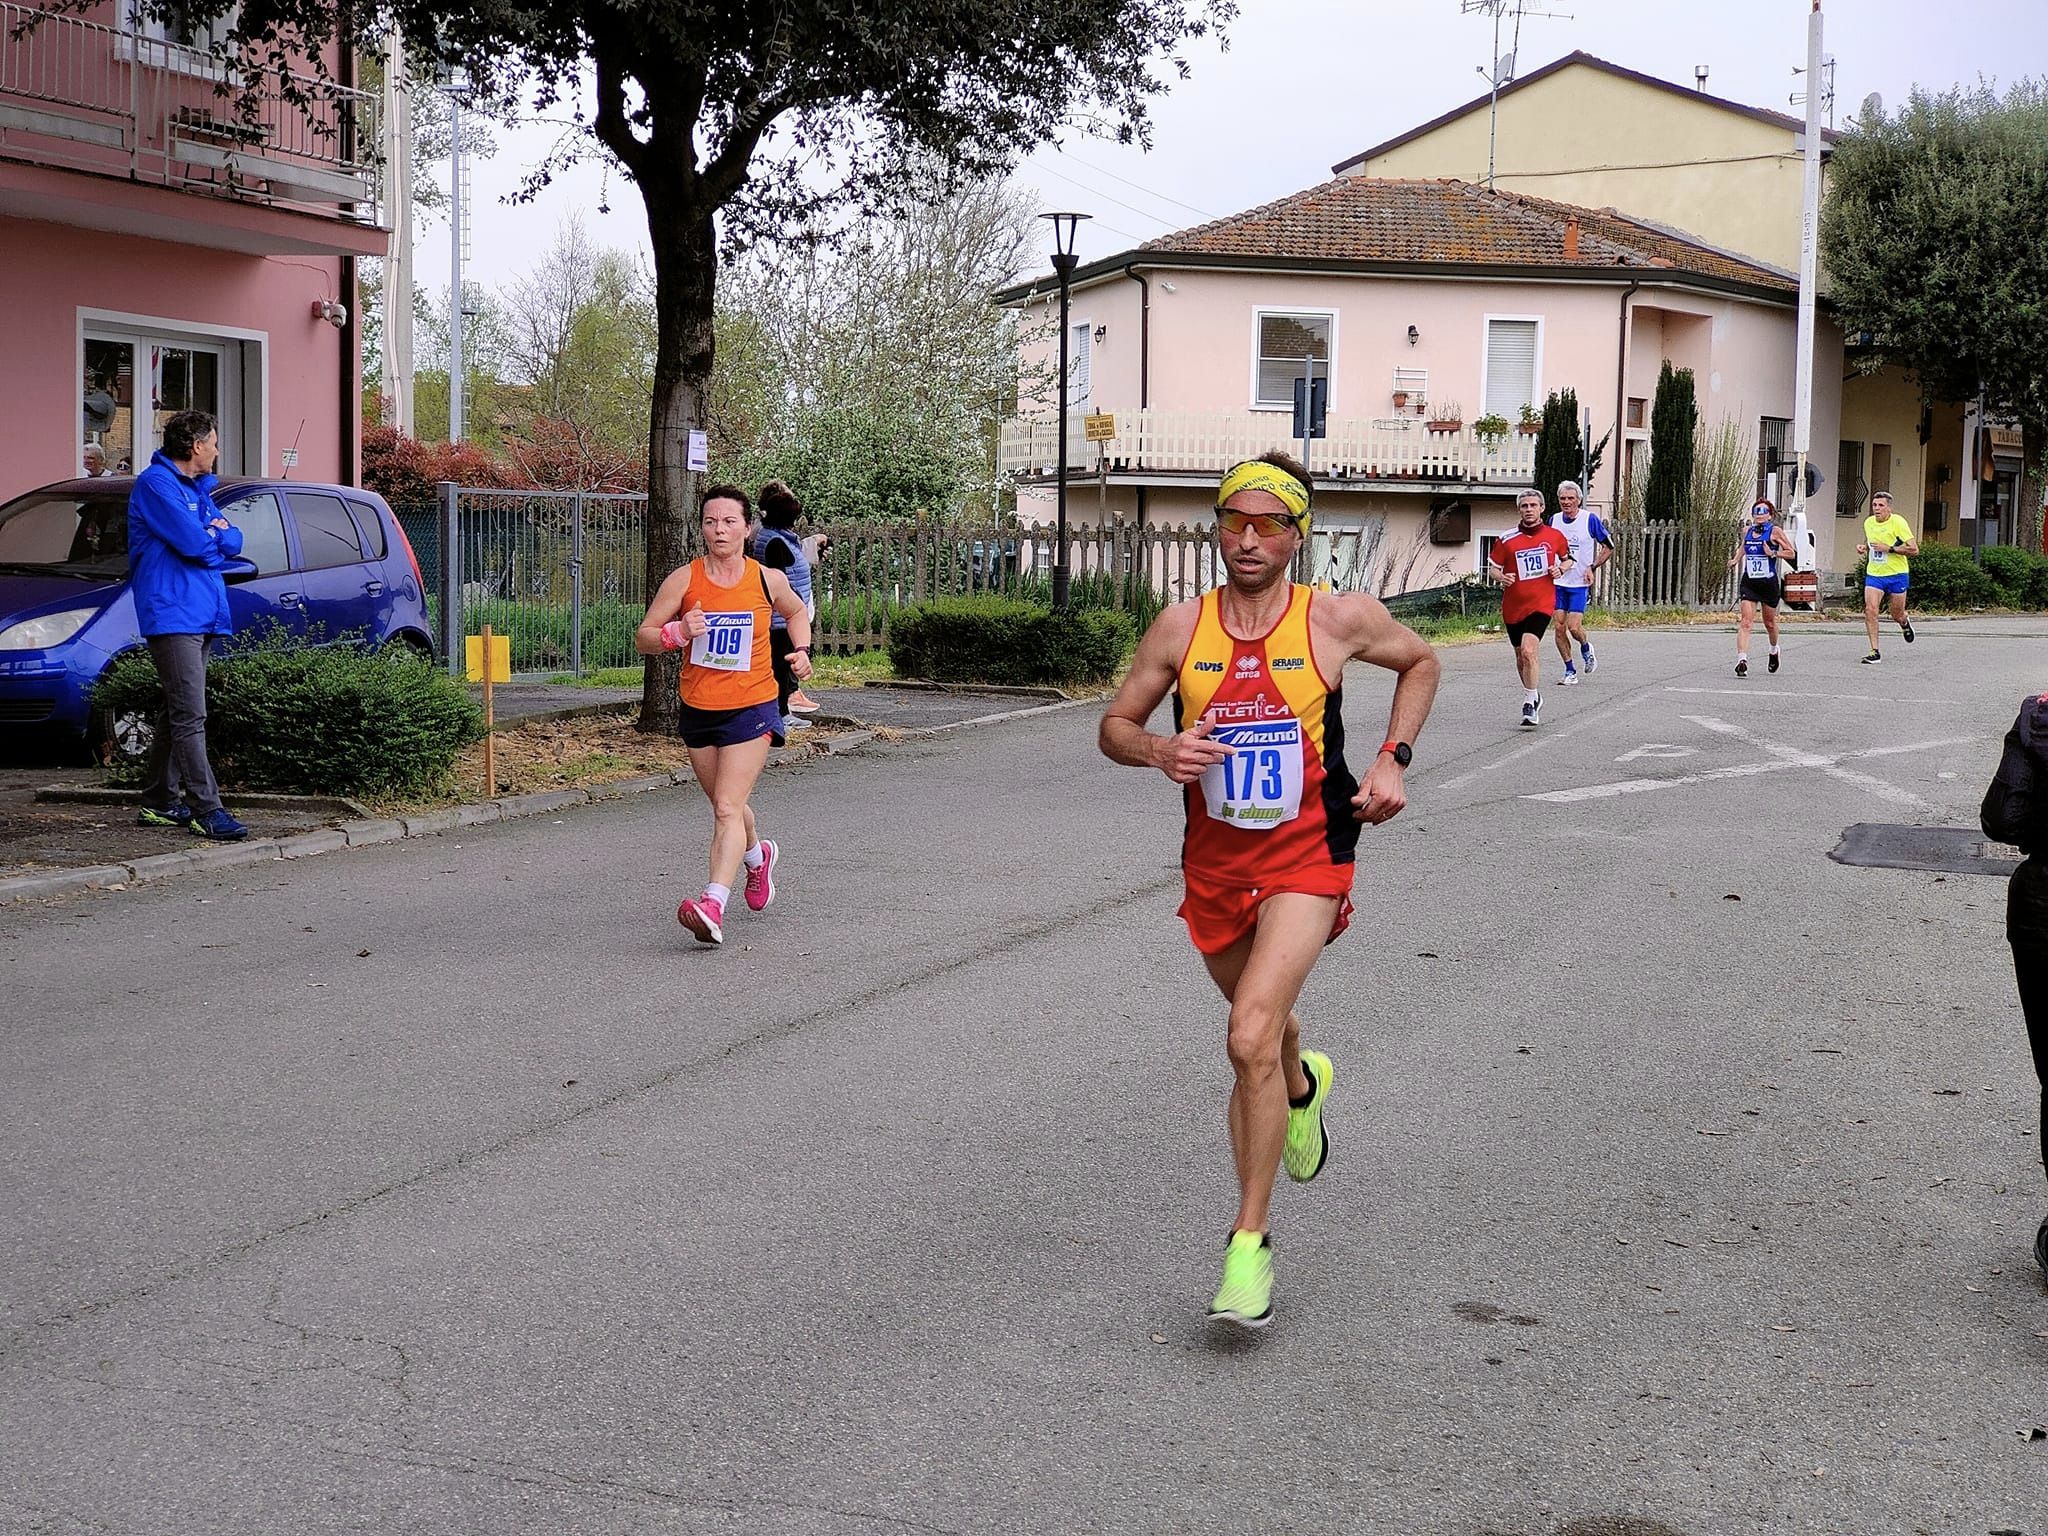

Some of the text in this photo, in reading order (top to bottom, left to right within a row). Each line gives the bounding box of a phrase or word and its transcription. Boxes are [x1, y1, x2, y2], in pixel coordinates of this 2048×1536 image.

[1523, 555, 1543, 571] 129
[1752, 560, 1763, 572] 32
[707, 628, 742, 655] 109
[1194, 661, 1224, 672] AVIS
[1272, 658, 1304, 668] BERARDI
[1224, 749, 1283, 801] 173
